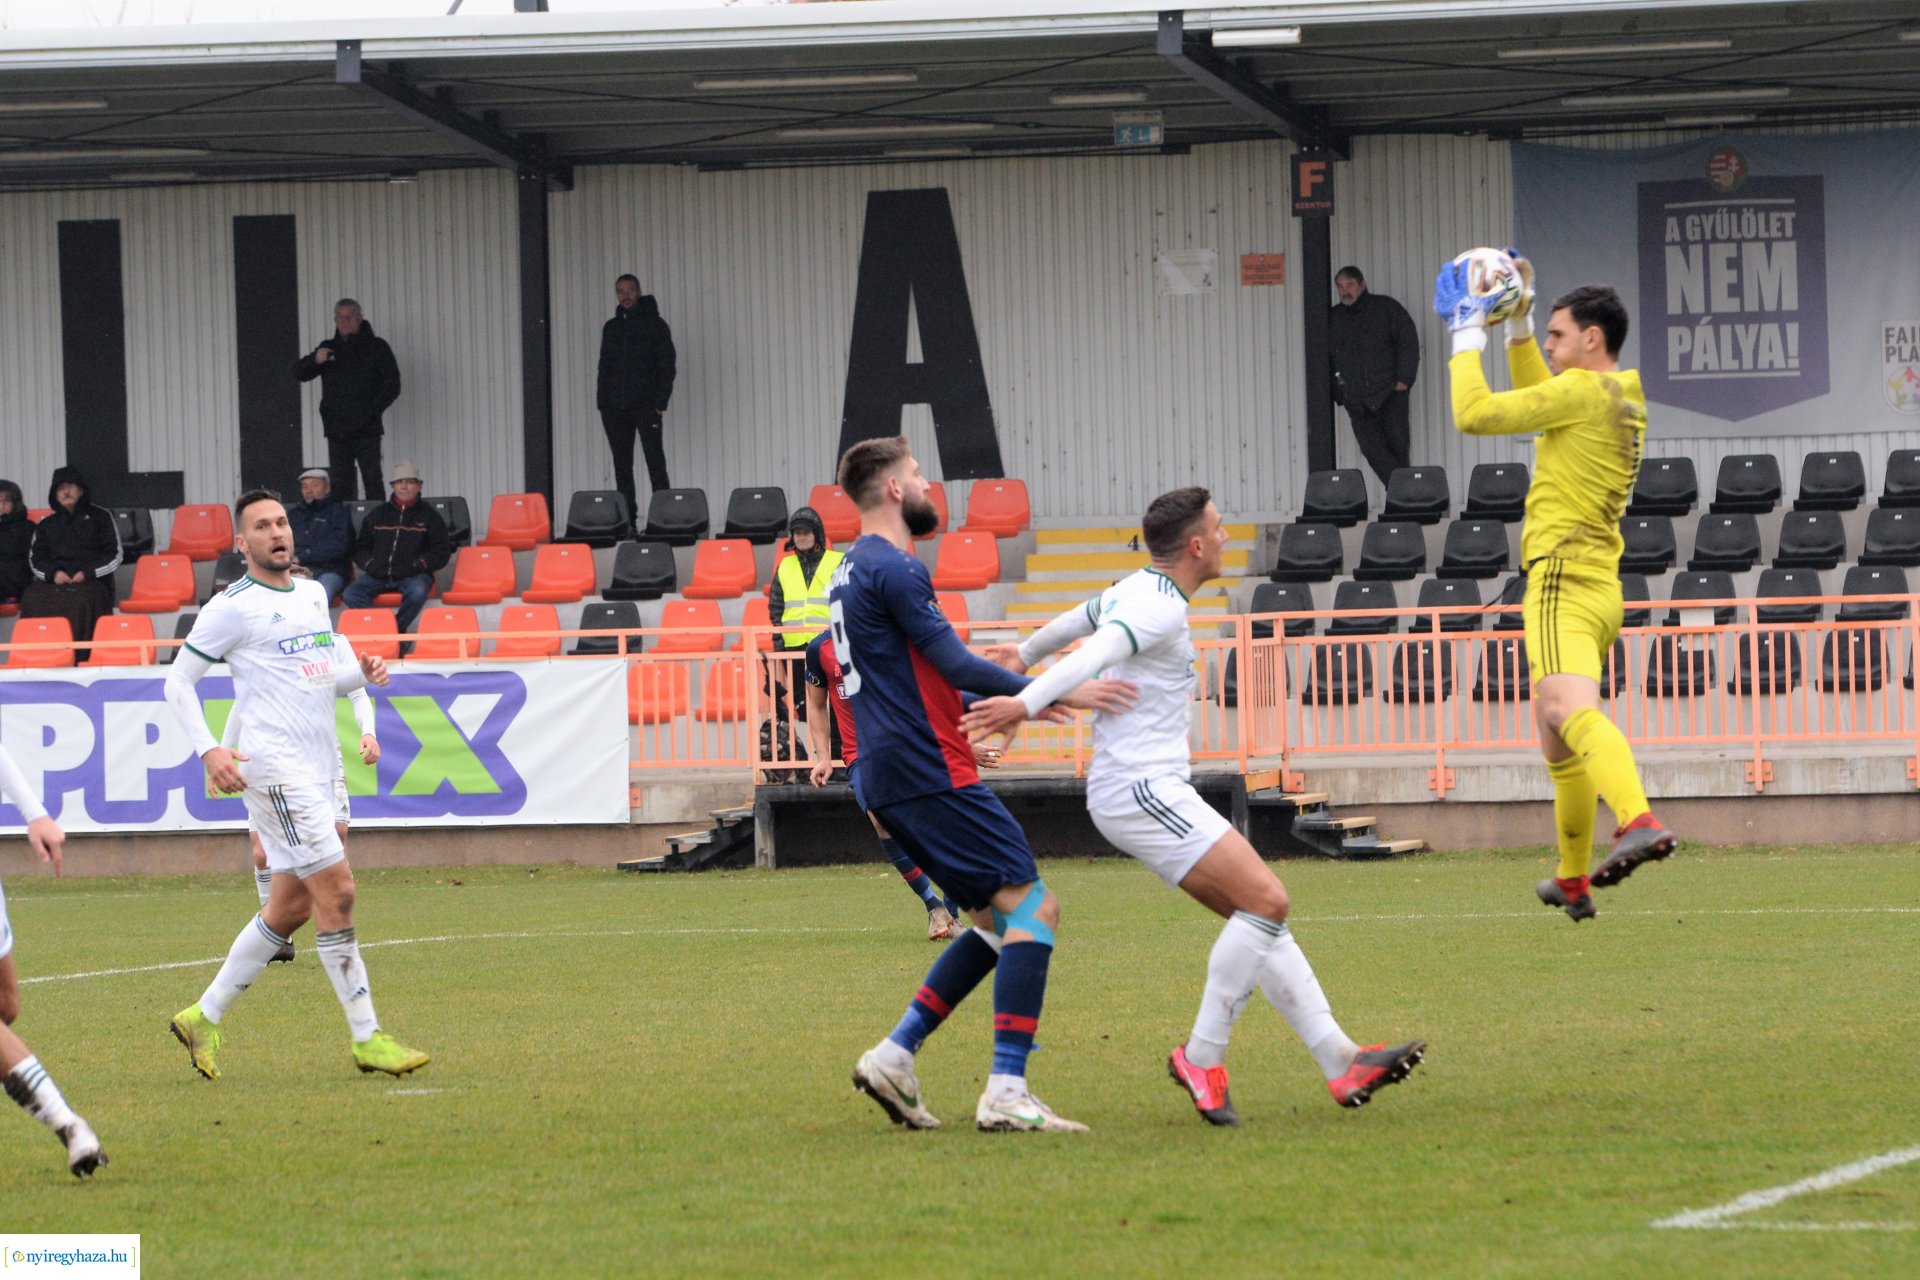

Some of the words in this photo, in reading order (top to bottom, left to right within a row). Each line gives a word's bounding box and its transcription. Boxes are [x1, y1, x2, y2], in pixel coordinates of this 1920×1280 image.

[1299, 162, 1326, 198] F
[1665, 216, 1681, 243] A
[1685, 207, 1796, 243] GYŰLÖLET
[1665, 240, 1799, 316] NEM
[1667, 316, 1800, 373] PÁLYA!
[1885, 326, 1920, 345] FAI
[1127, 534, 1140, 551] 4
